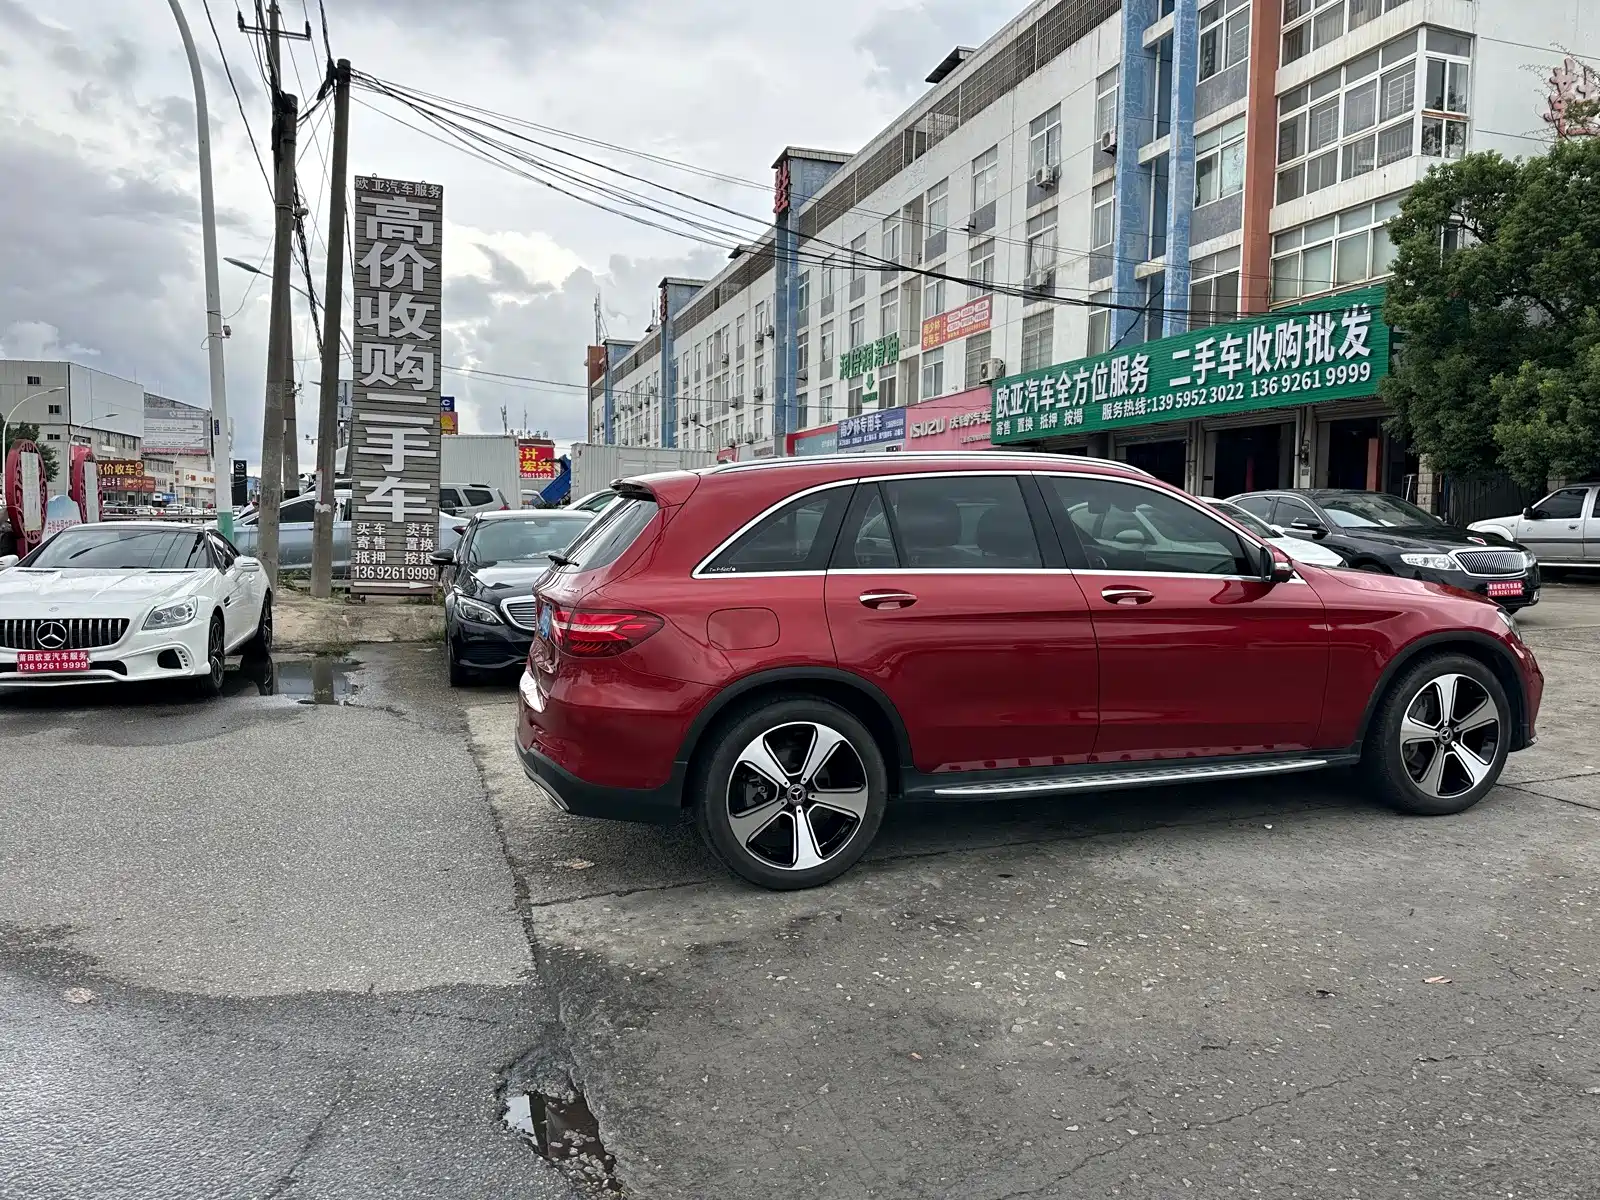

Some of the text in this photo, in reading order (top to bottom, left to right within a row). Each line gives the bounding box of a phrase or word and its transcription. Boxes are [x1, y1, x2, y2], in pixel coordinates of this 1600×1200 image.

[355, 176, 441, 199] 欧亚汽车服务
[1169, 302, 1372, 388] 二手车收购批发
[356, 196, 437, 523] 高价收购二手车
[996, 353, 1150, 419] 欧亚汽车全方位服务
[910, 418, 946, 438] ISUZU
[995, 408, 1083, 436] 寄售 置换 抵押 按揭
[356, 522, 434, 537] 买车 卖车
[356, 536, 434, 551] 寄售 置换
[355, 551, 387, 564] 抵押
[19, 652, 87, 662] 莆田欧亚汽车服务
